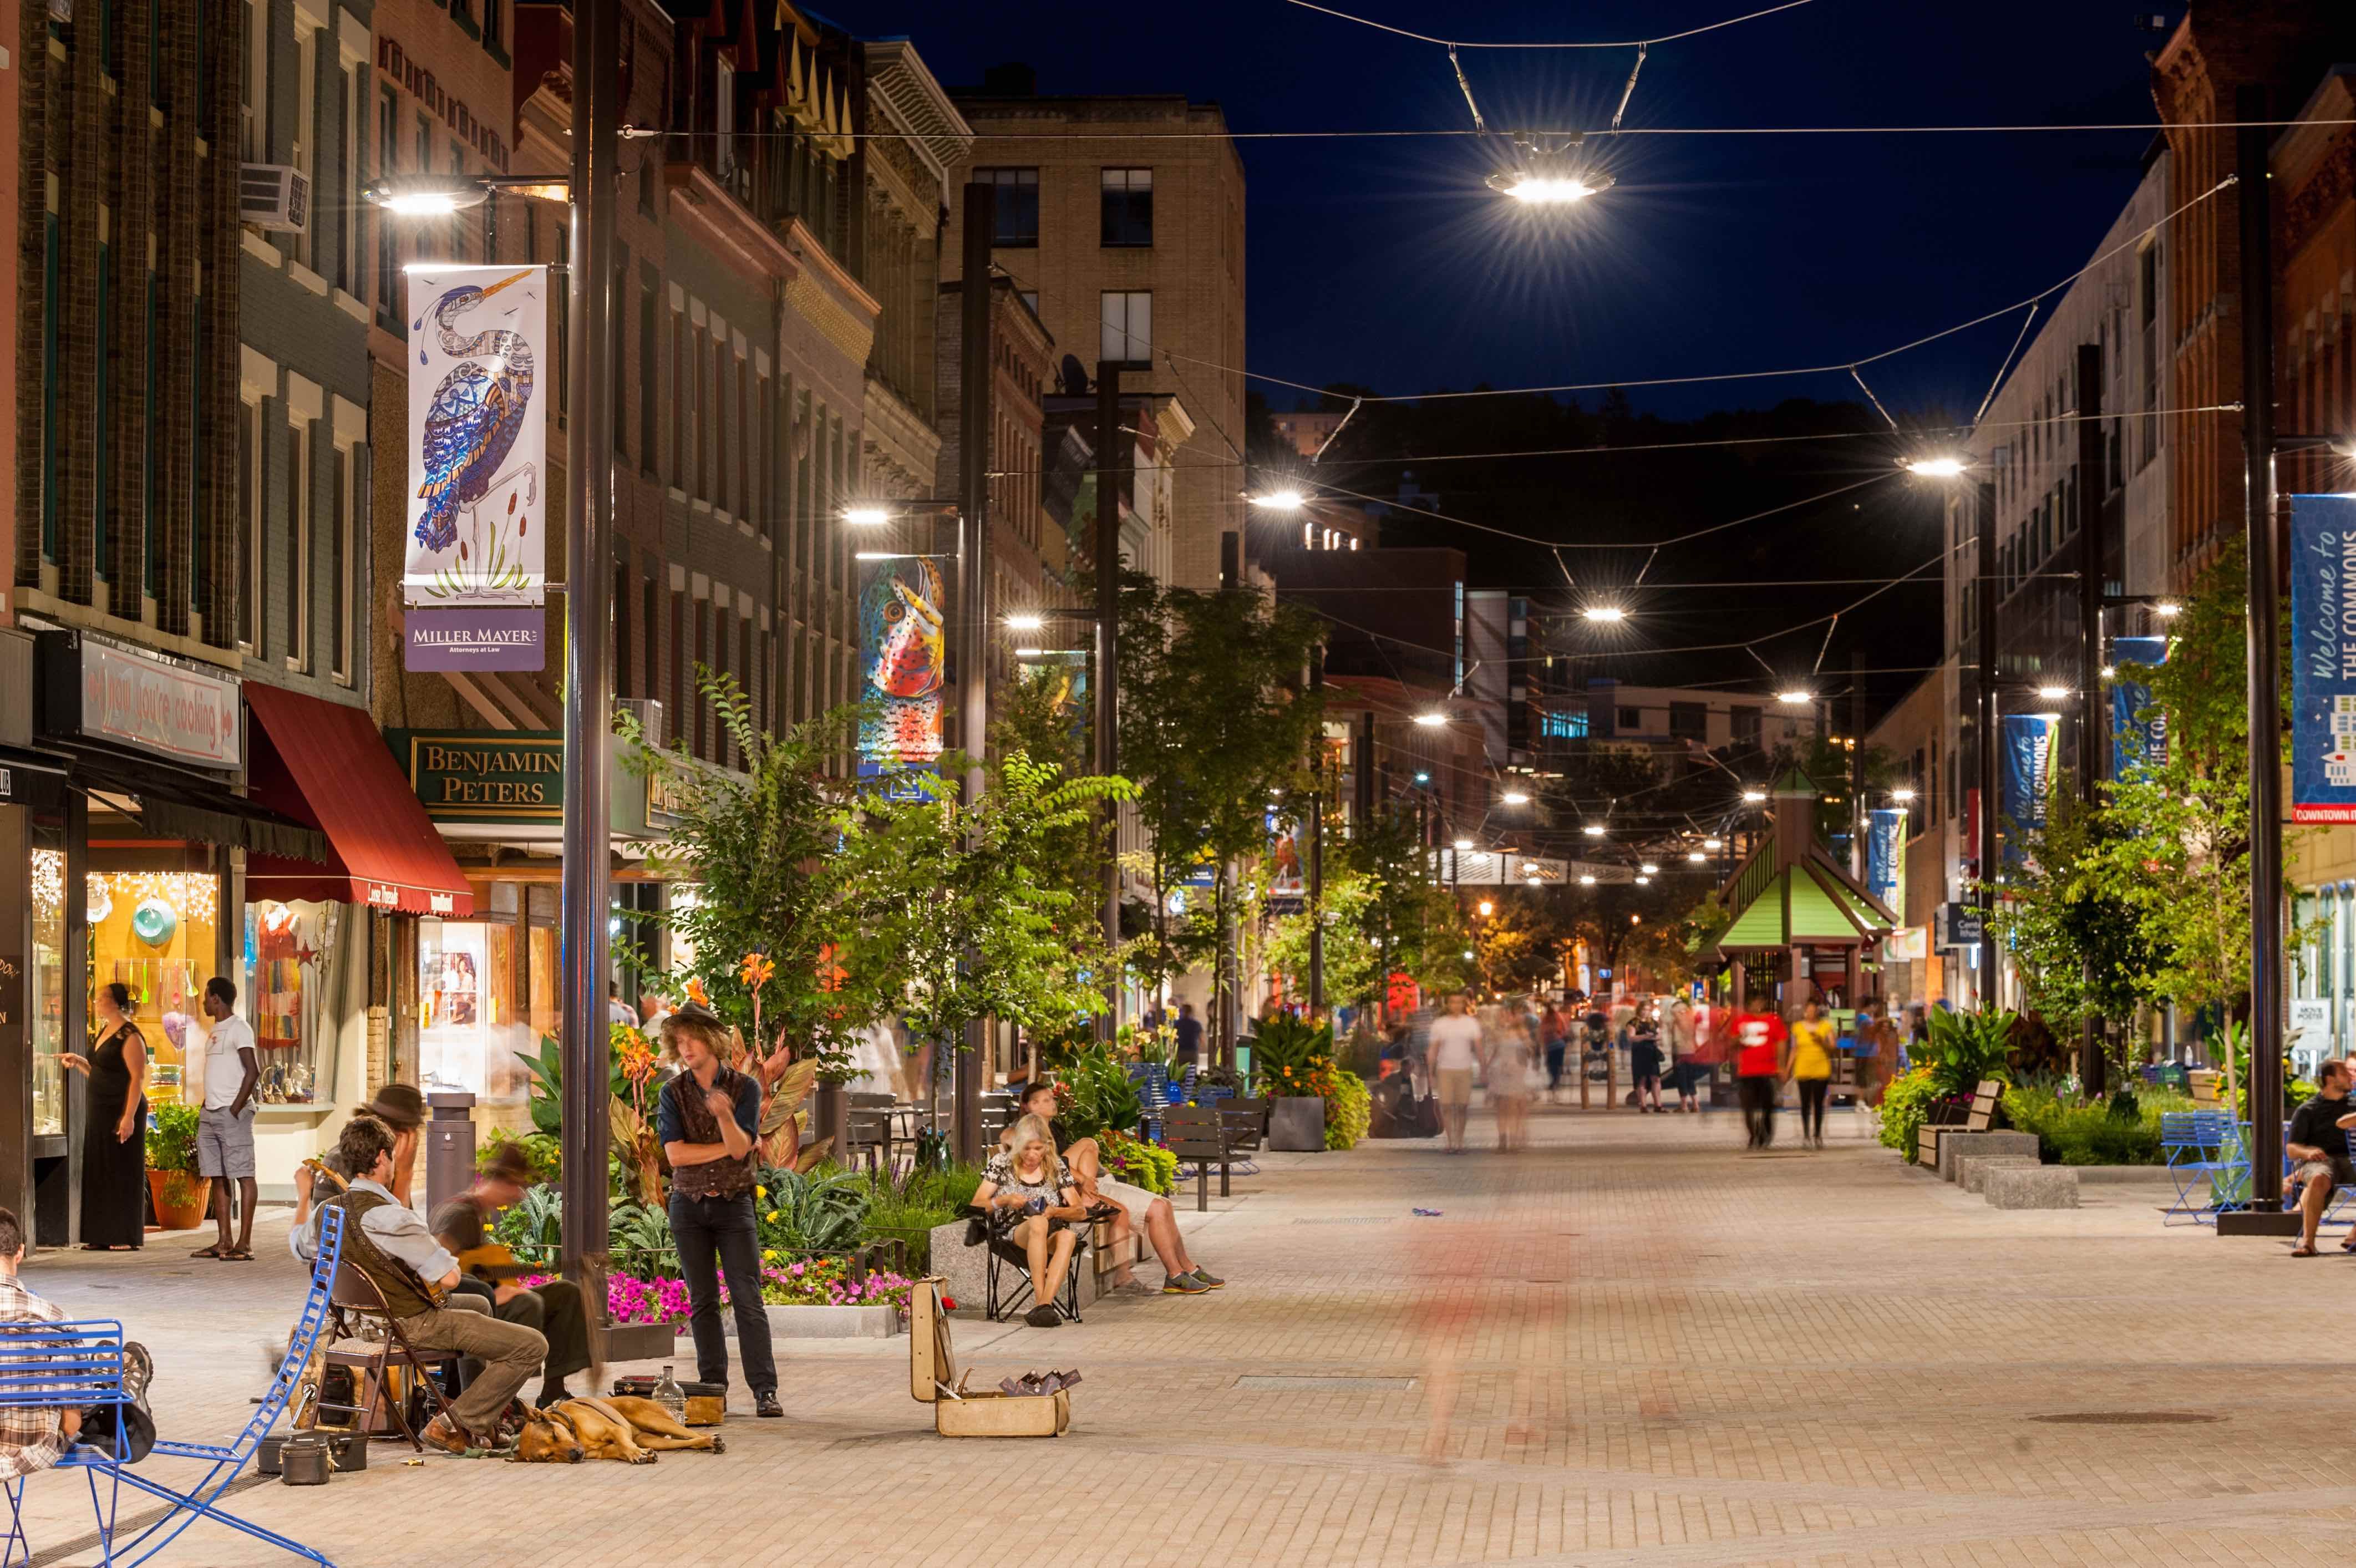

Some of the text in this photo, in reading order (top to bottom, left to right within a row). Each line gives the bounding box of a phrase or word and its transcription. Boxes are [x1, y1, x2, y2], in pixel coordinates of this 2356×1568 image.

[2310, 531, 2337, 678] Welcome to
[413, 628, 471, 643] MILLER
[478, 628, 532, 642] MAYER
[109, 673, 215, 750] now you're cooking
[425, 747, 562, 776] BENJAMIN
[2015, 737, 2031, 819] Welcome to
[2034, 735, 2048, 796] COMMONS
[442, 777, 544, 803] PETERS
[2296, 810, 2349, 820] DOWNTOWN
